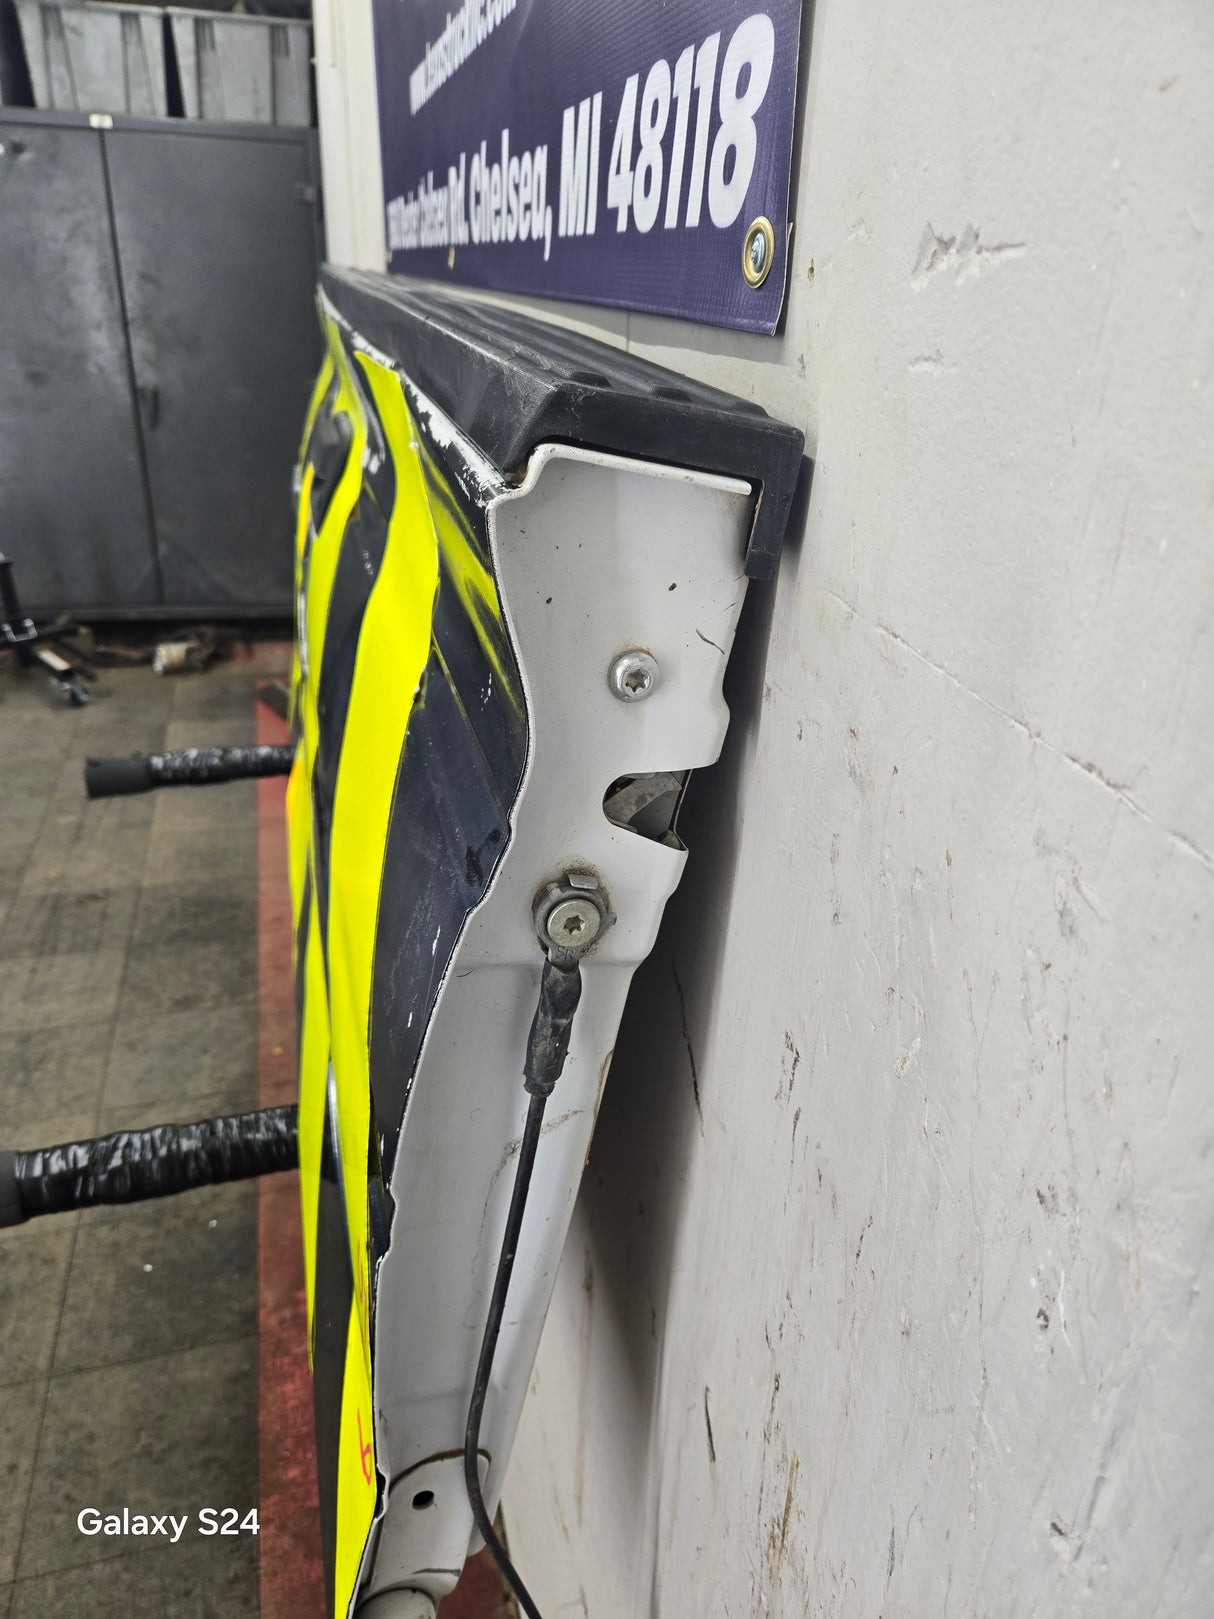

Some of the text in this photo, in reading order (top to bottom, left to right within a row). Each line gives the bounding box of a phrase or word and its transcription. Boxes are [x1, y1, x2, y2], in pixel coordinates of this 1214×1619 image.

[469, 128, 553, 261] Chelsea,
[558, 91, 603, 238] MI
[607, 13, 775, 234] 48118
